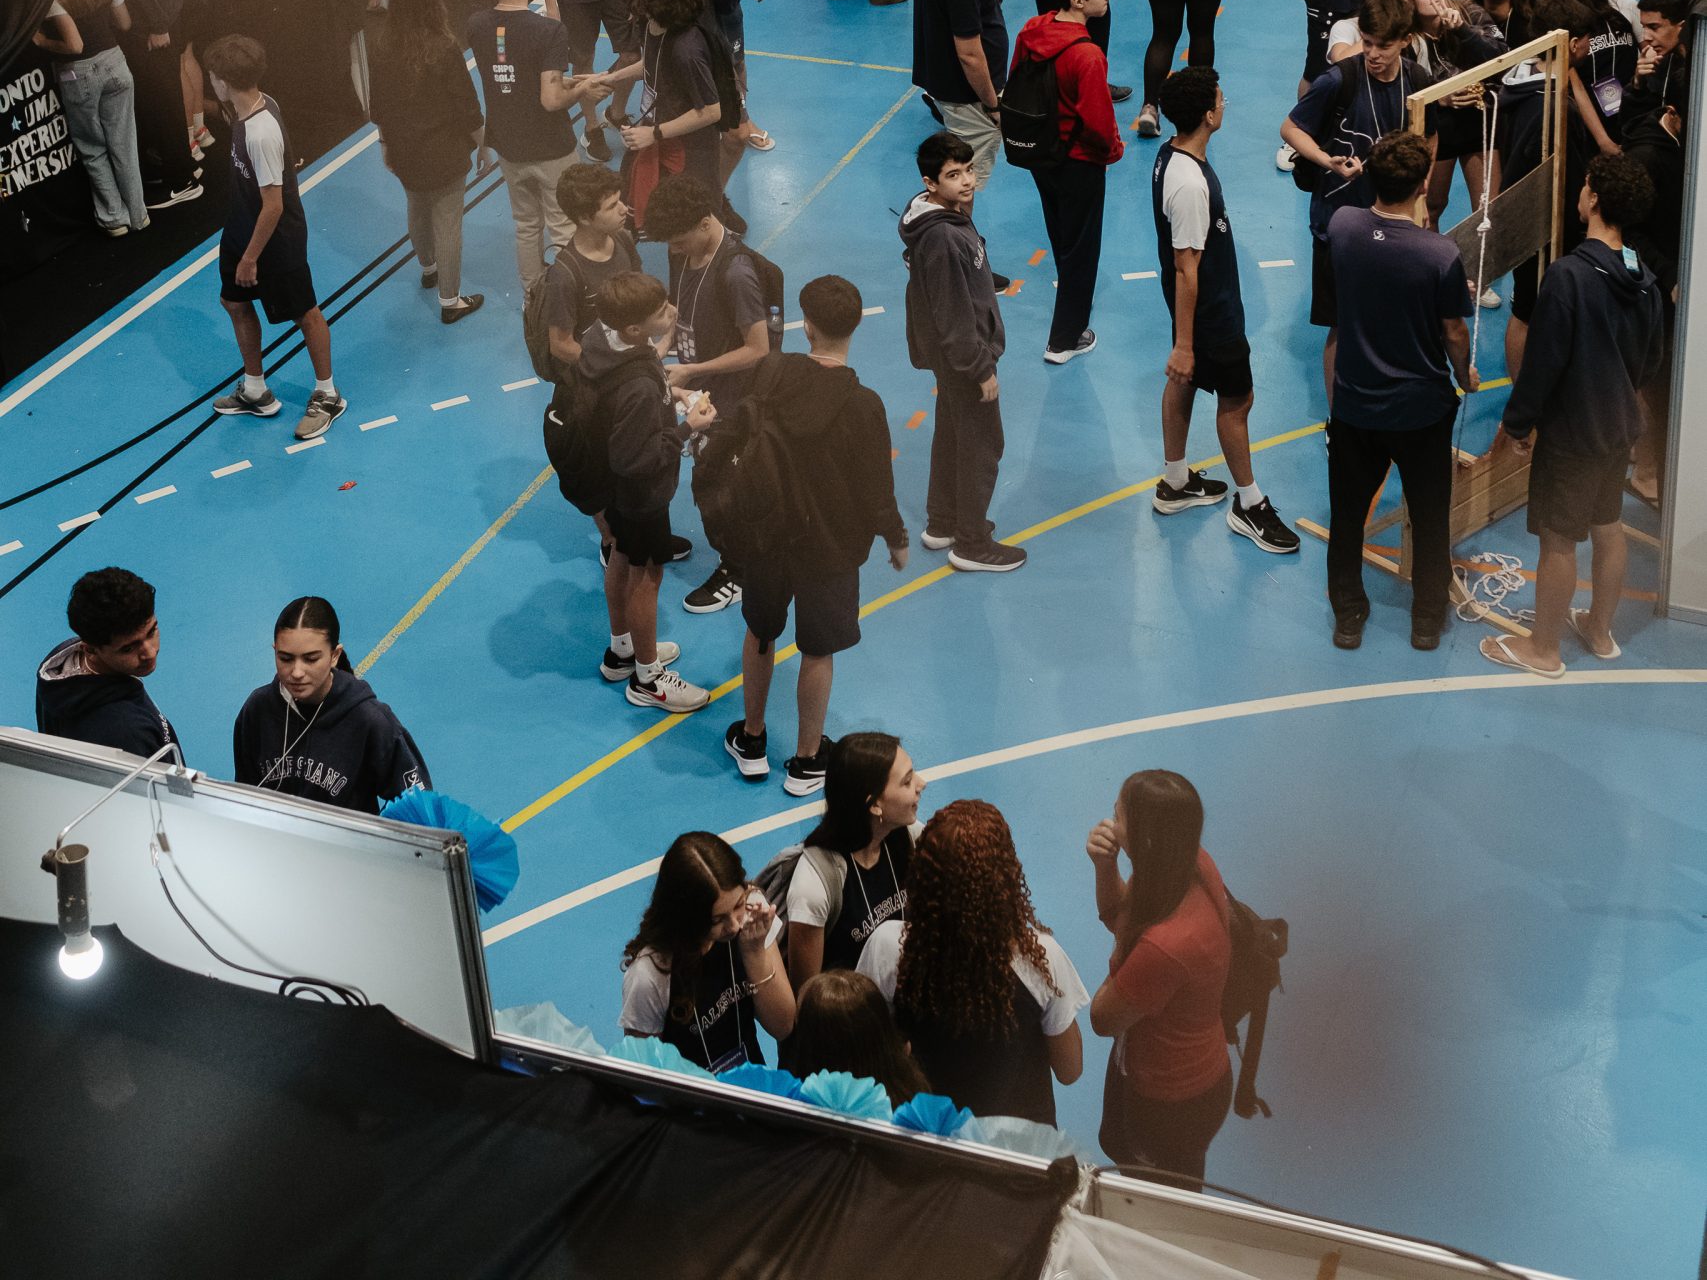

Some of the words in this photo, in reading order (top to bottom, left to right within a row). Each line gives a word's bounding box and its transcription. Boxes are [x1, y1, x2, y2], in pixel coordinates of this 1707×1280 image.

[24, 89, 61, 127] UMA
[851, 888, 908, 942] SALESIAN
[689, 981, 748, 1034] SALESIA
